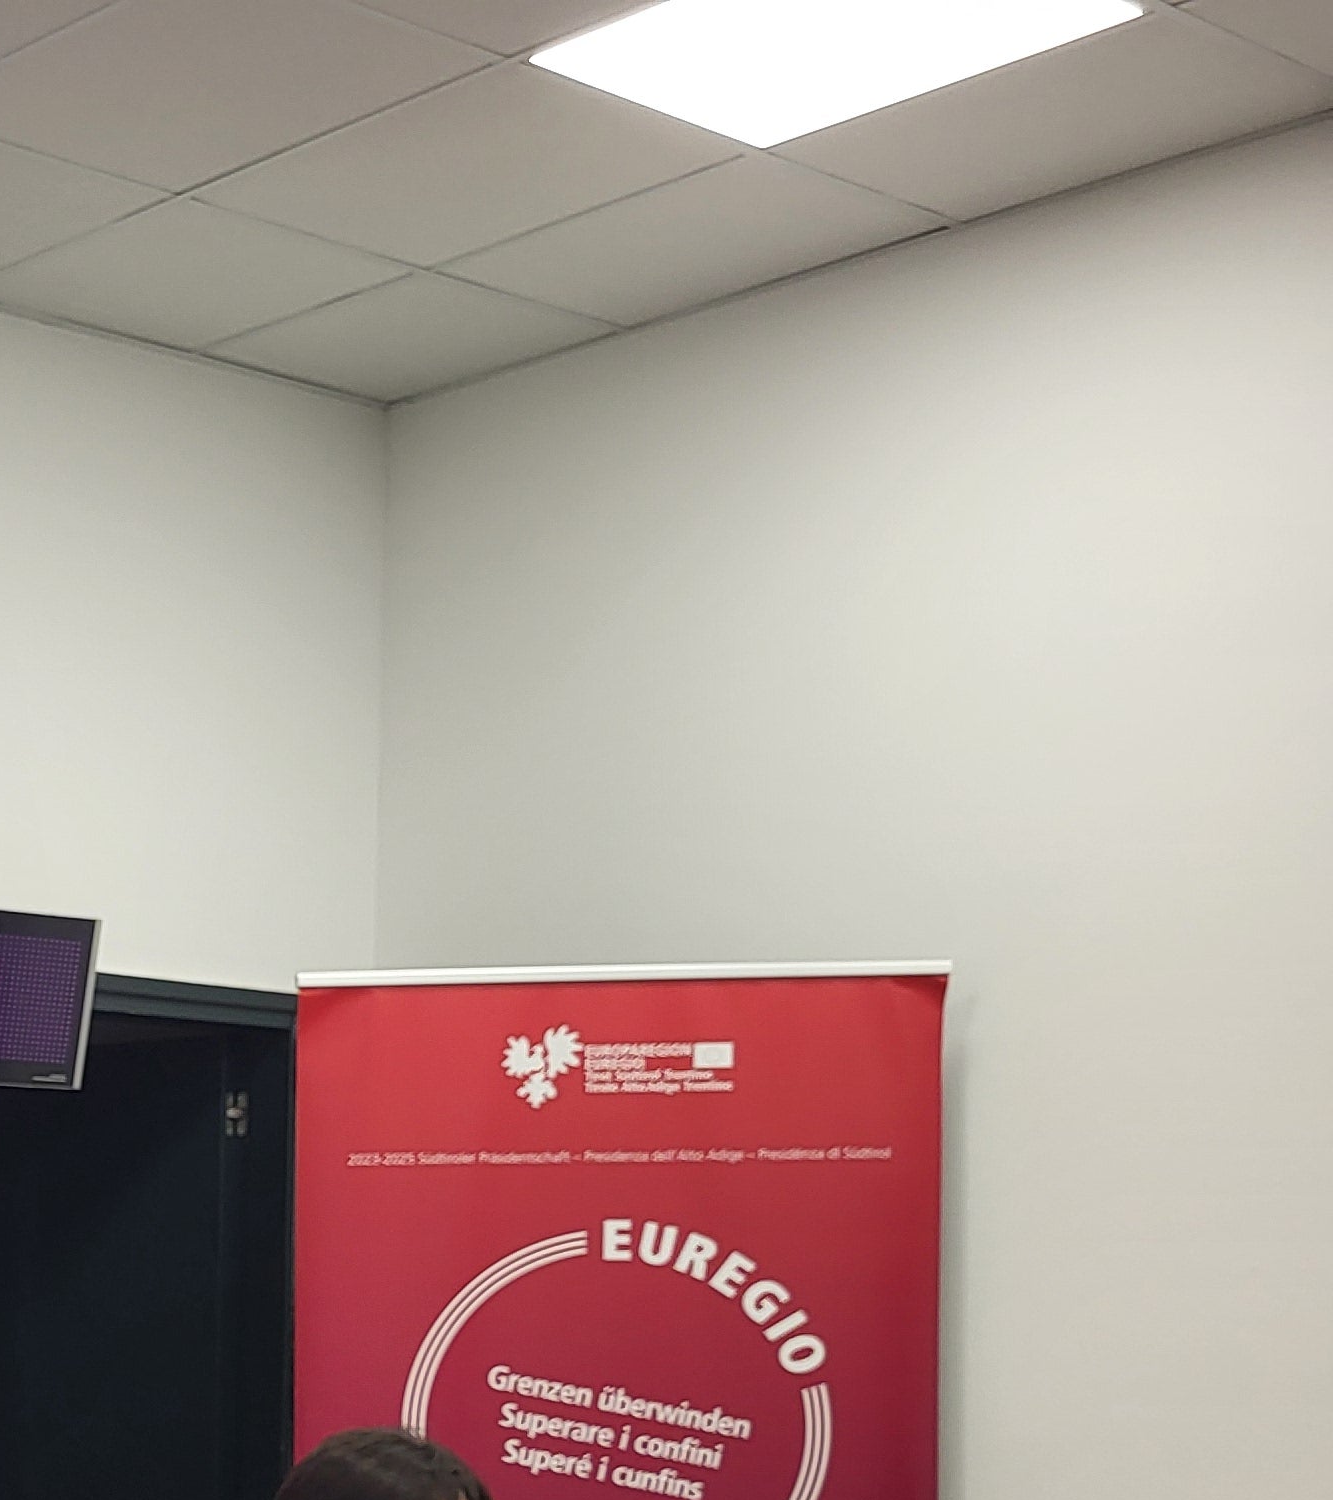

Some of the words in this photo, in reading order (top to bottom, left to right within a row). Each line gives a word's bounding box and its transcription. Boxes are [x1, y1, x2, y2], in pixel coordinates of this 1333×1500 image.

[600, 1218, 828, 1375] EUREGIO
[487, 1364, 593, 1409] Grenzen
[597, 1385, 752, 1440] überwinden
[498, 1402, 615, 1448] Superare
[618, 1424, 631, 1450] i
[634, 1434, 725, 1470] confini
[501, 1438, 593, 1476] Superé
[596, 1456, 609, 1482] i
